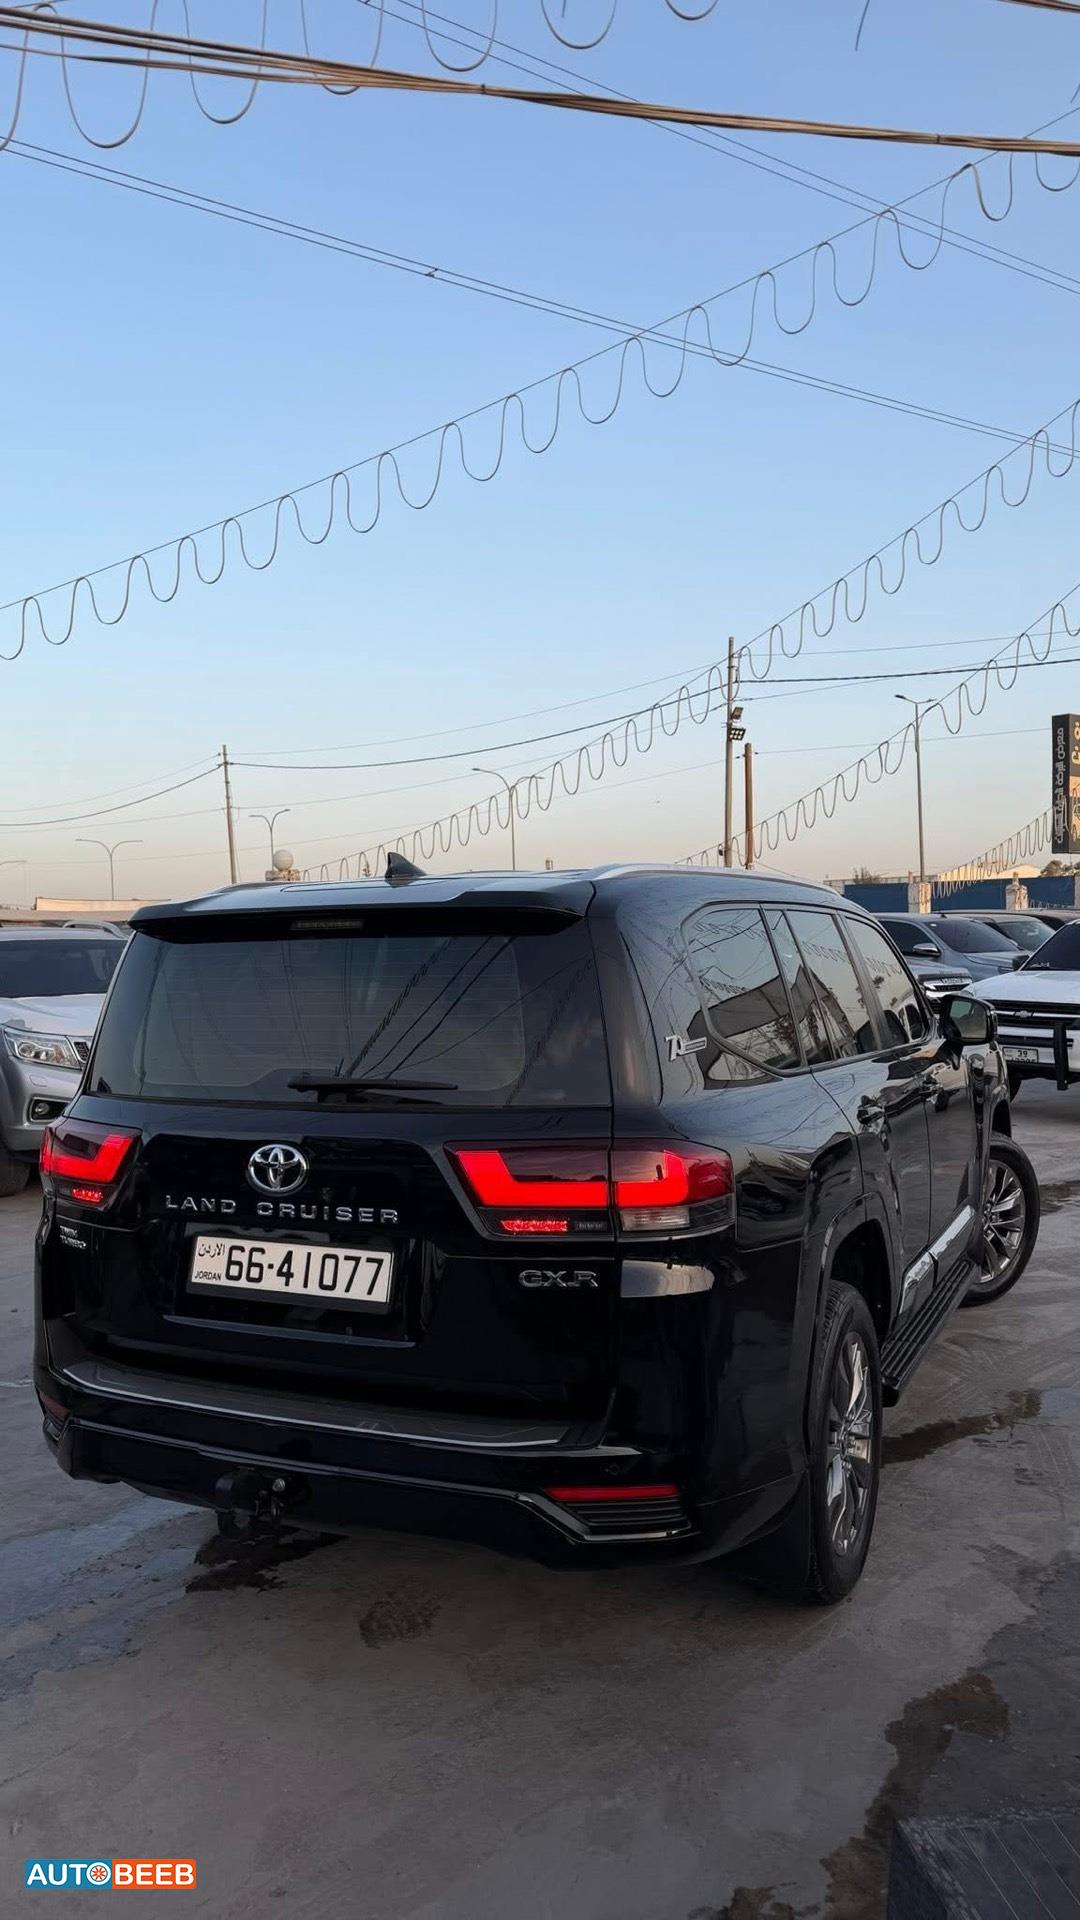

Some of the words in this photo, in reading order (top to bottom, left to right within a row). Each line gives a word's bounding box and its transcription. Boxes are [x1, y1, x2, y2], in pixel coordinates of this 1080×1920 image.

[165, 1194, 237, 1214] LAND
[256, 1201, 399, 1224] CRUISER
[194, 1270, 222, 1281] JORDAN
[224, 1245, 385, 1296] 66-41077
[518, 1269, 599, 1288] GXR
